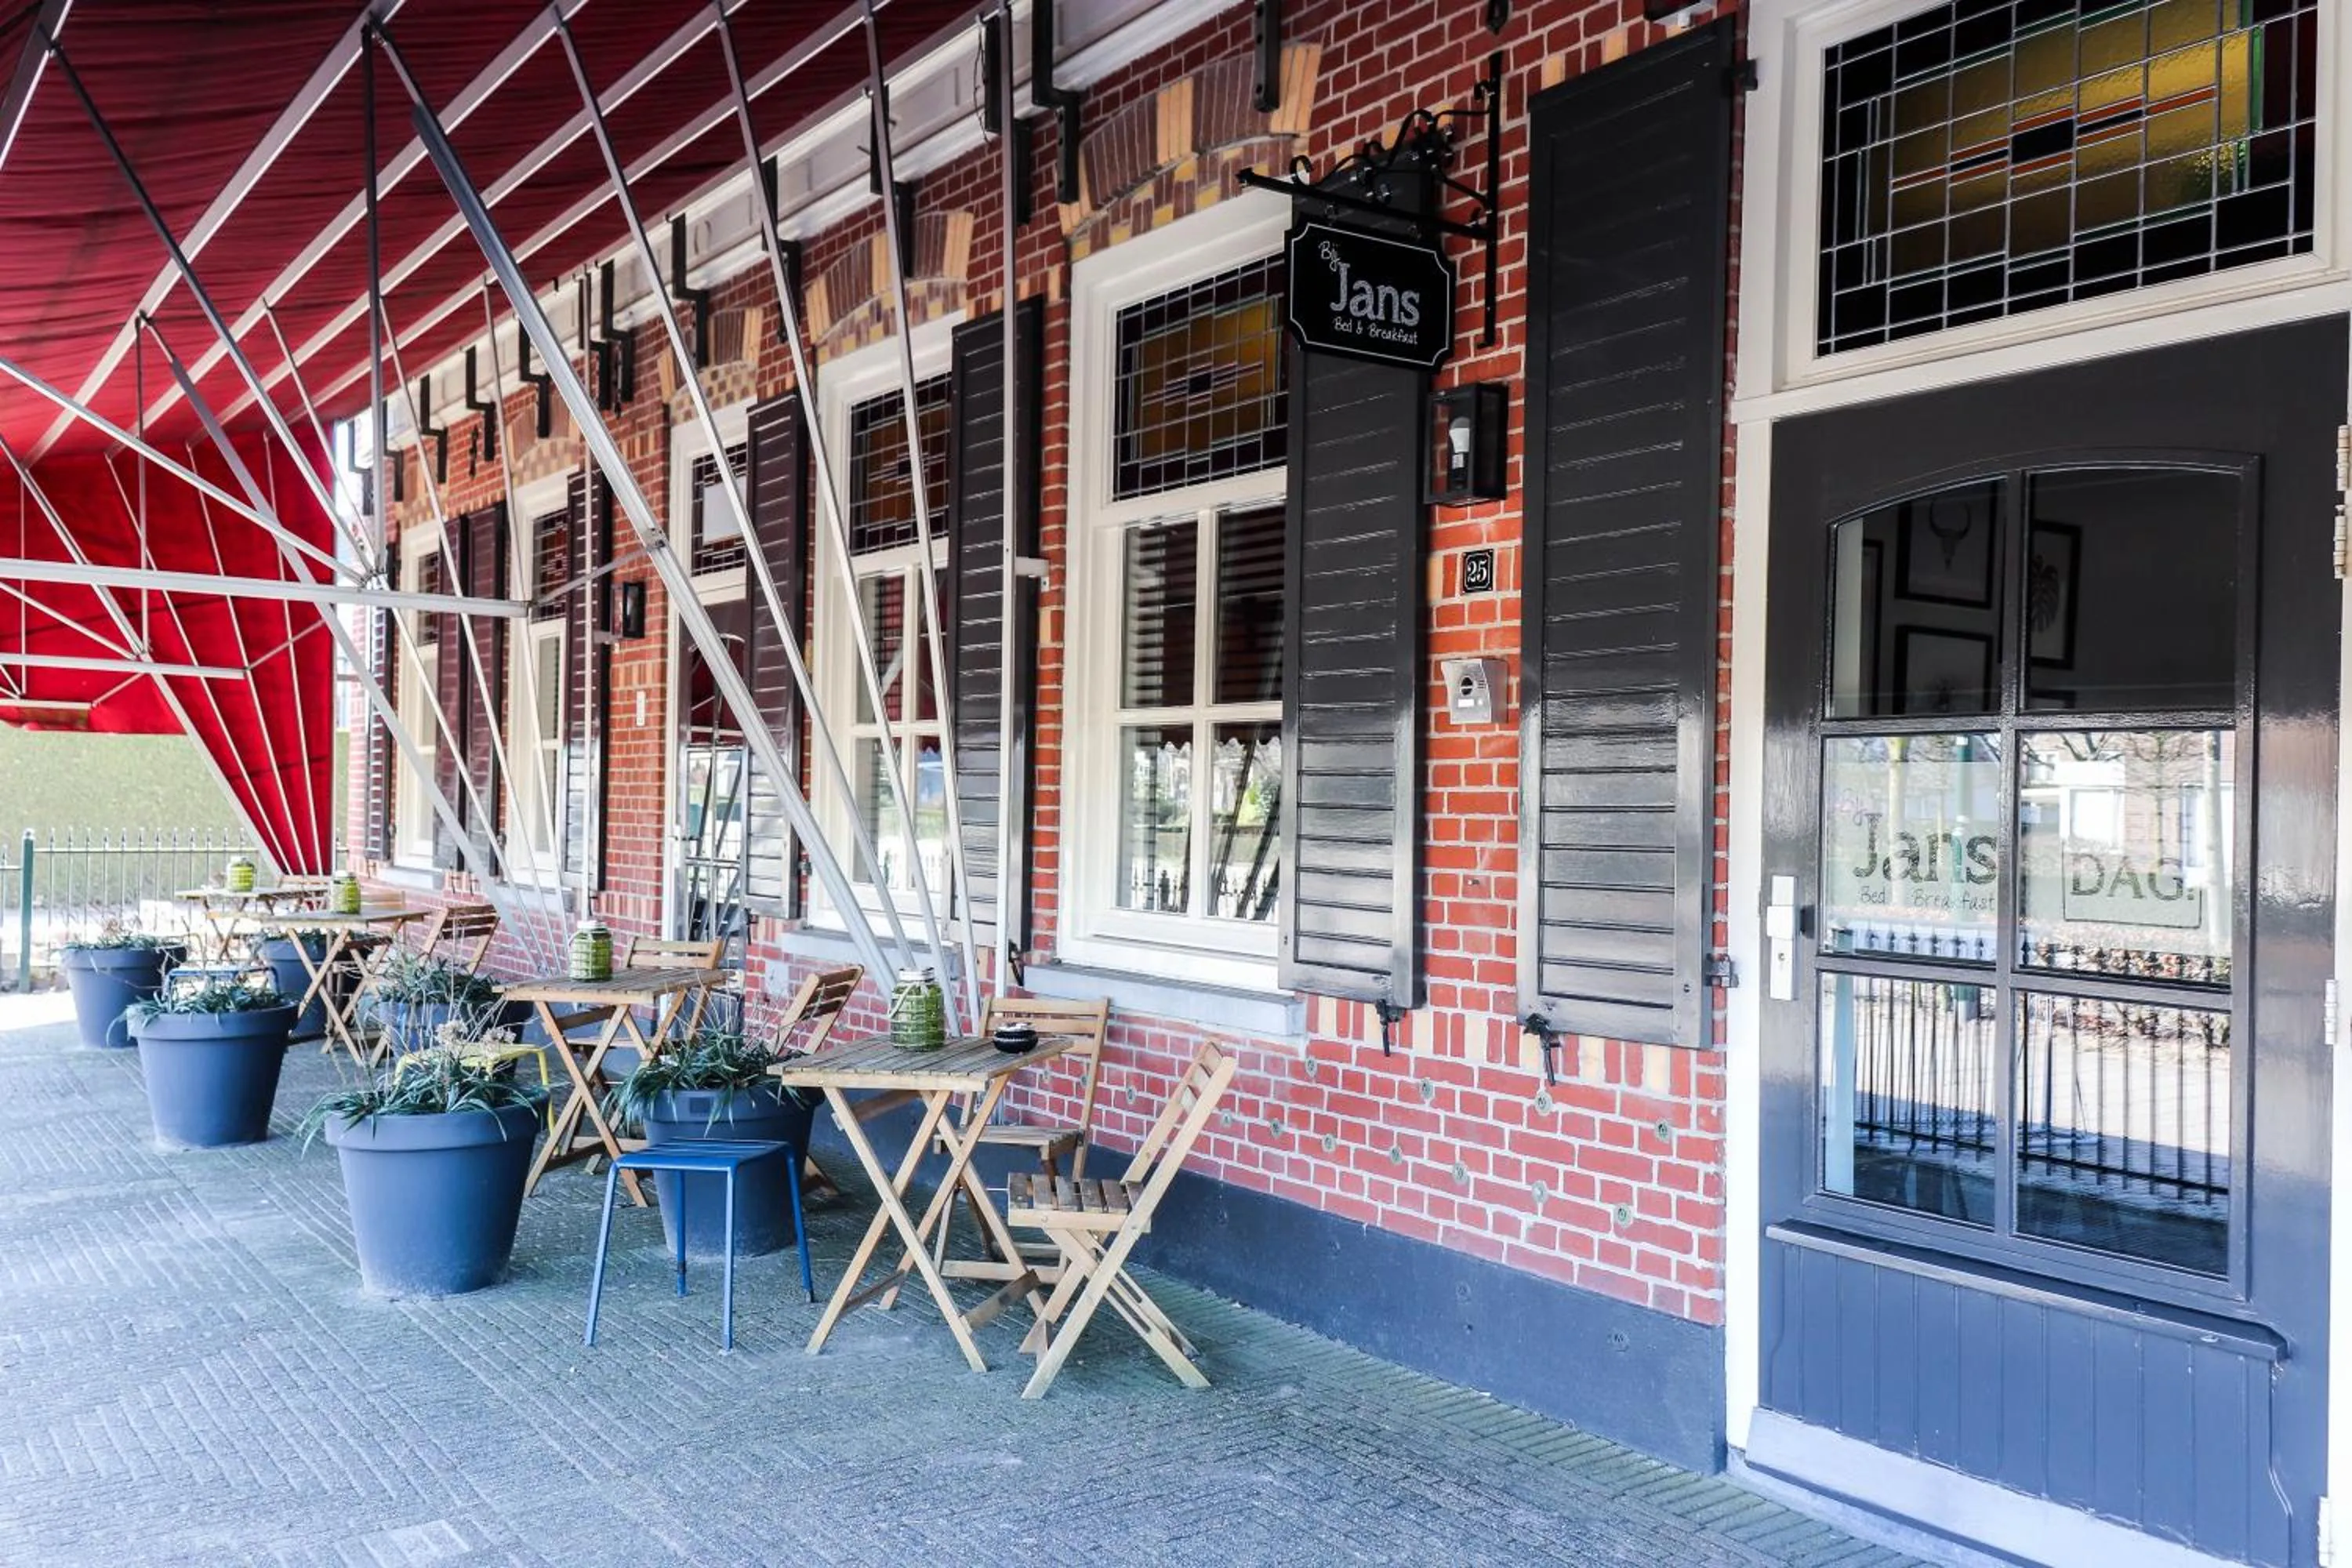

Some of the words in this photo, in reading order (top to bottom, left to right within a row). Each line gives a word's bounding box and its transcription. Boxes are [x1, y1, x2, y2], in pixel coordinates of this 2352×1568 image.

[1329, 262, 1420, 327] Jans
[1334, 316, 1353, 333] Bed
[1356, 319, 1363, 335] &
[1369, 322, 1418, 345] Breakfast
[1467, 558, 1488, 583] 25
[1852, 812, 1997, 885] Jans
[2070, 852, 2194, 901] DAG
[1859, 885, 1886, 905] Bed
[1913, 887, 1996, 911] Breafast
